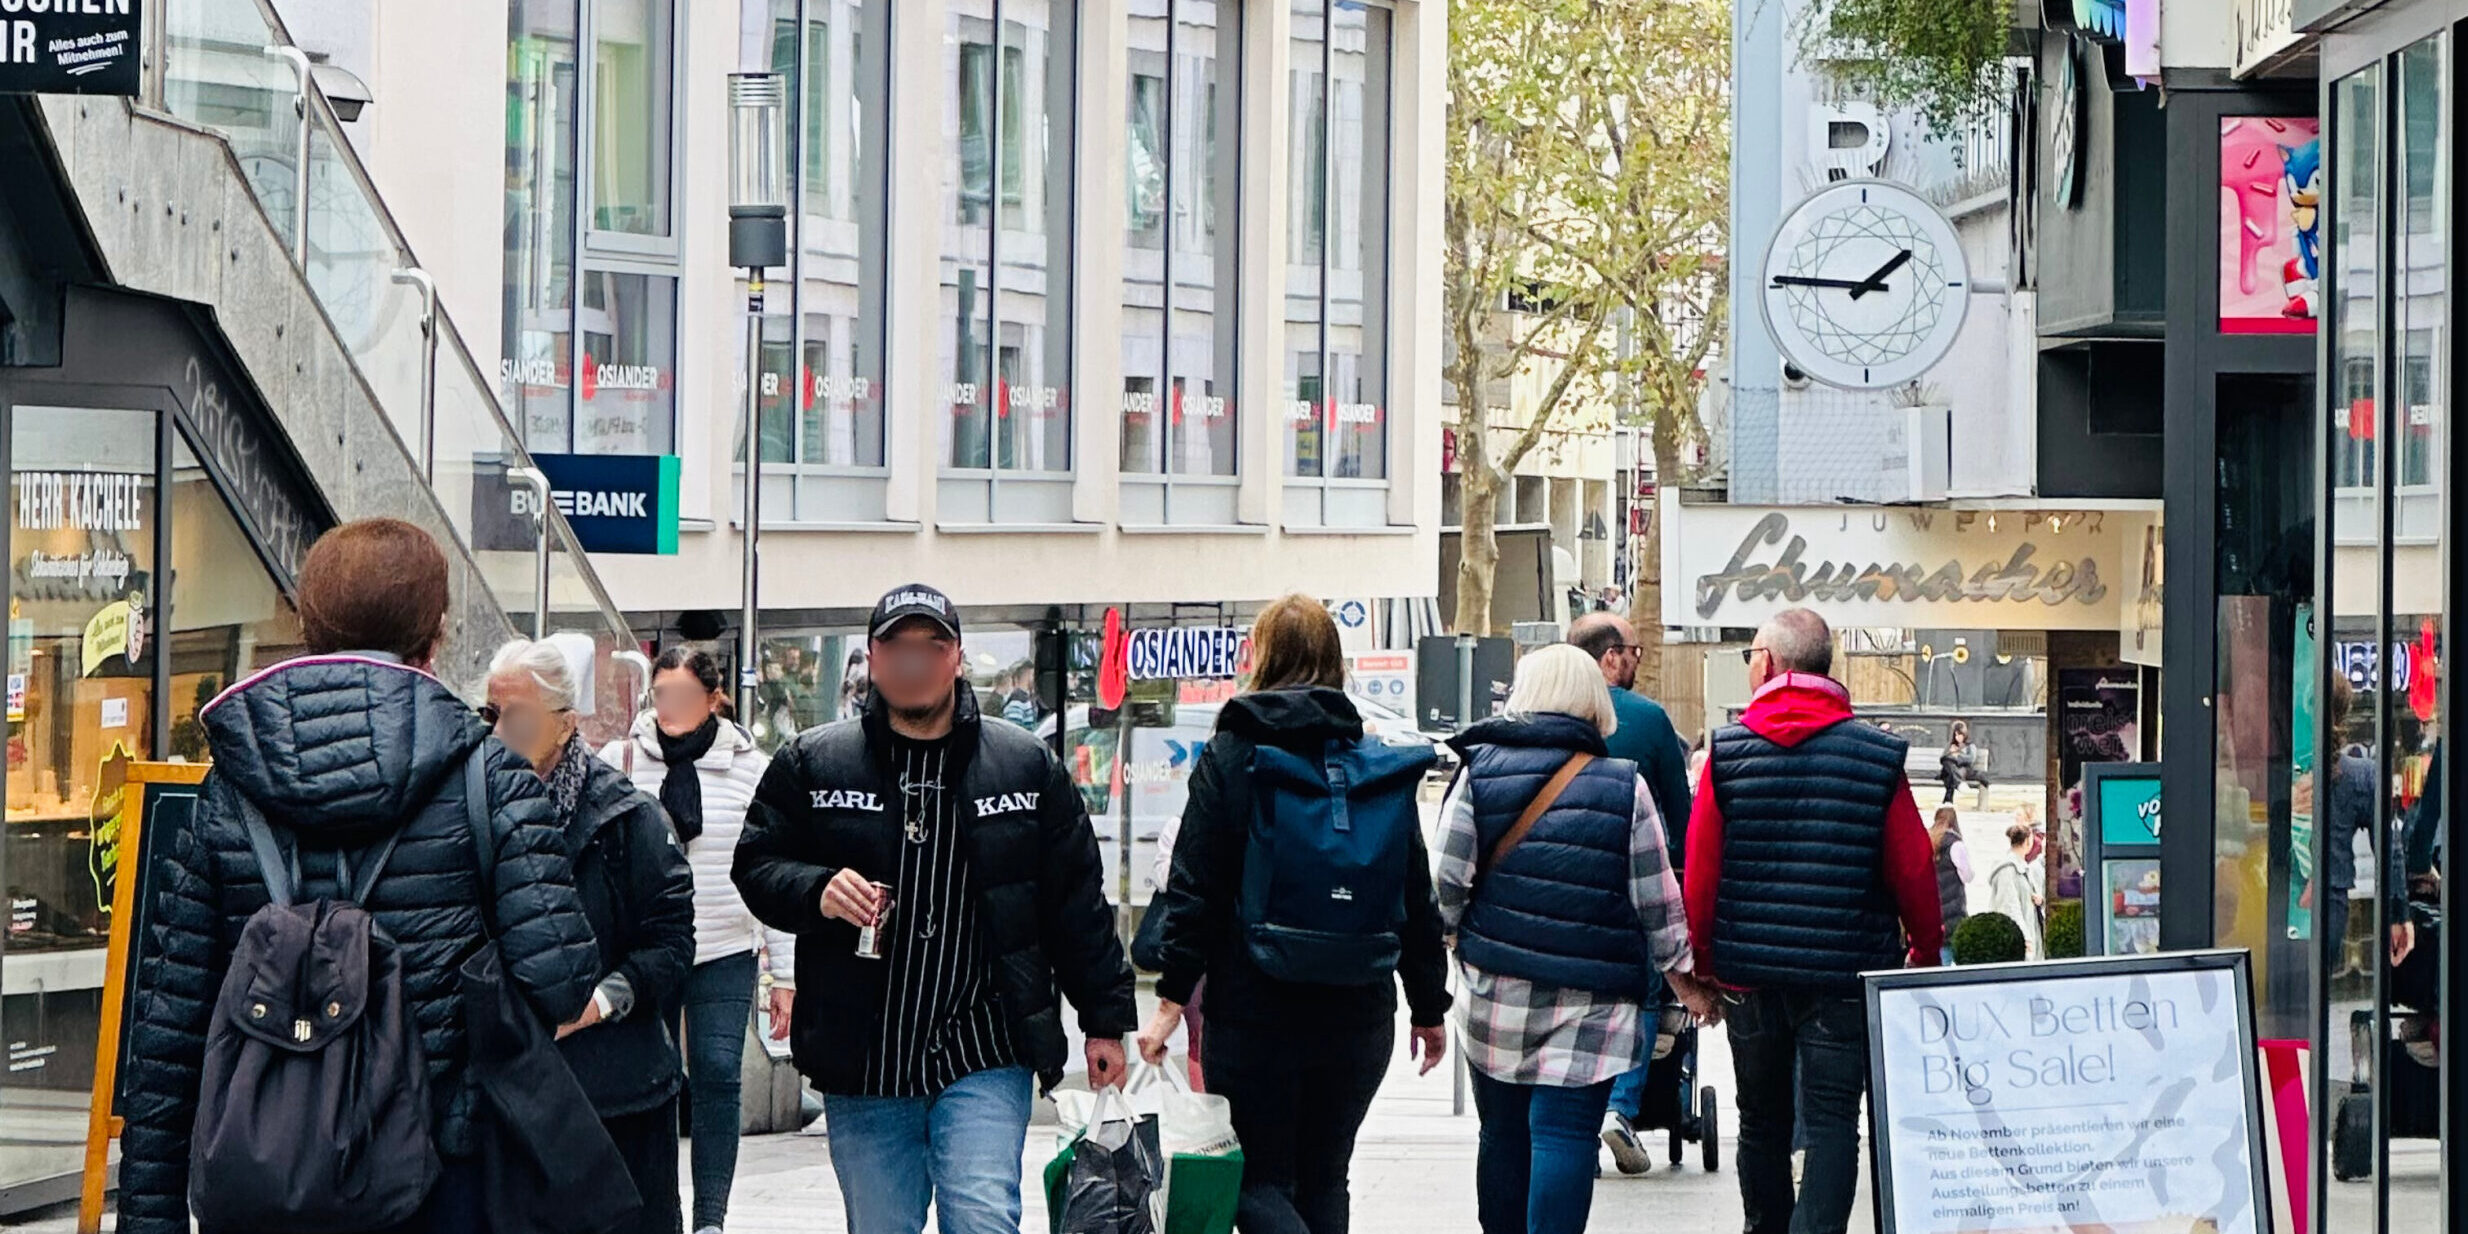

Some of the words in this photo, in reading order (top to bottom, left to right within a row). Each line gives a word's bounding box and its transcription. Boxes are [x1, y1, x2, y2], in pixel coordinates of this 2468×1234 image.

[48, 39, 75, 52] Alles
[77, 33, 103, 47] auch
[104, 30, 128, 42] zum
[57, 44, 123, 65] Mitnehmen!
[20, 472, 63, 530] HERR
[70, 462, 142, 531] KÄCHELE
[576, 491, 647, 517] BANK
[1696, 512, 2105, 620] Schumacher
[809, 789, 884, 812] KARL
[1919, 1001, 2012, 1044] DUX
[2029, 996, 2179, 1038] Betten
[1922, 1055, 1992, 1106] Big
[2007, 1043, 2116, 1089] Sale!
[1928, 1128, 1947, 1141] Ab
[1951, 1126, 2028, 1141] November
[2031, 1119, 2124, 1139] präsentieren
[2127, 1119, 2149, 1130] wir
[2154, 1115, 2185, 1129] eine
[1928, 1147, 1966, 1161] neue
[1969, 1142, 2095, 1159] Bettenkollektion.
[1930, 1168, 1958, 1180] Aus
[1961, 1165, 2014, 1179] diesem
[2018, 1161, 2063, 1175] Grund
[2067, 1159, 2113, 1172] bieten
[2117, 1157, 2139, 1169] wir
[2144, 1156, 2194, 1169] unsere
[1931, 1182, 2076, 1199] Ausstellungsbetten
[2100, 1177, 2145, 1190] einem
[1932, 1204, 2014, 1220] einmaligen
[2018, 1202, 2054, 1215] Preis
[2057, 1200, 2080, 1212] an!
